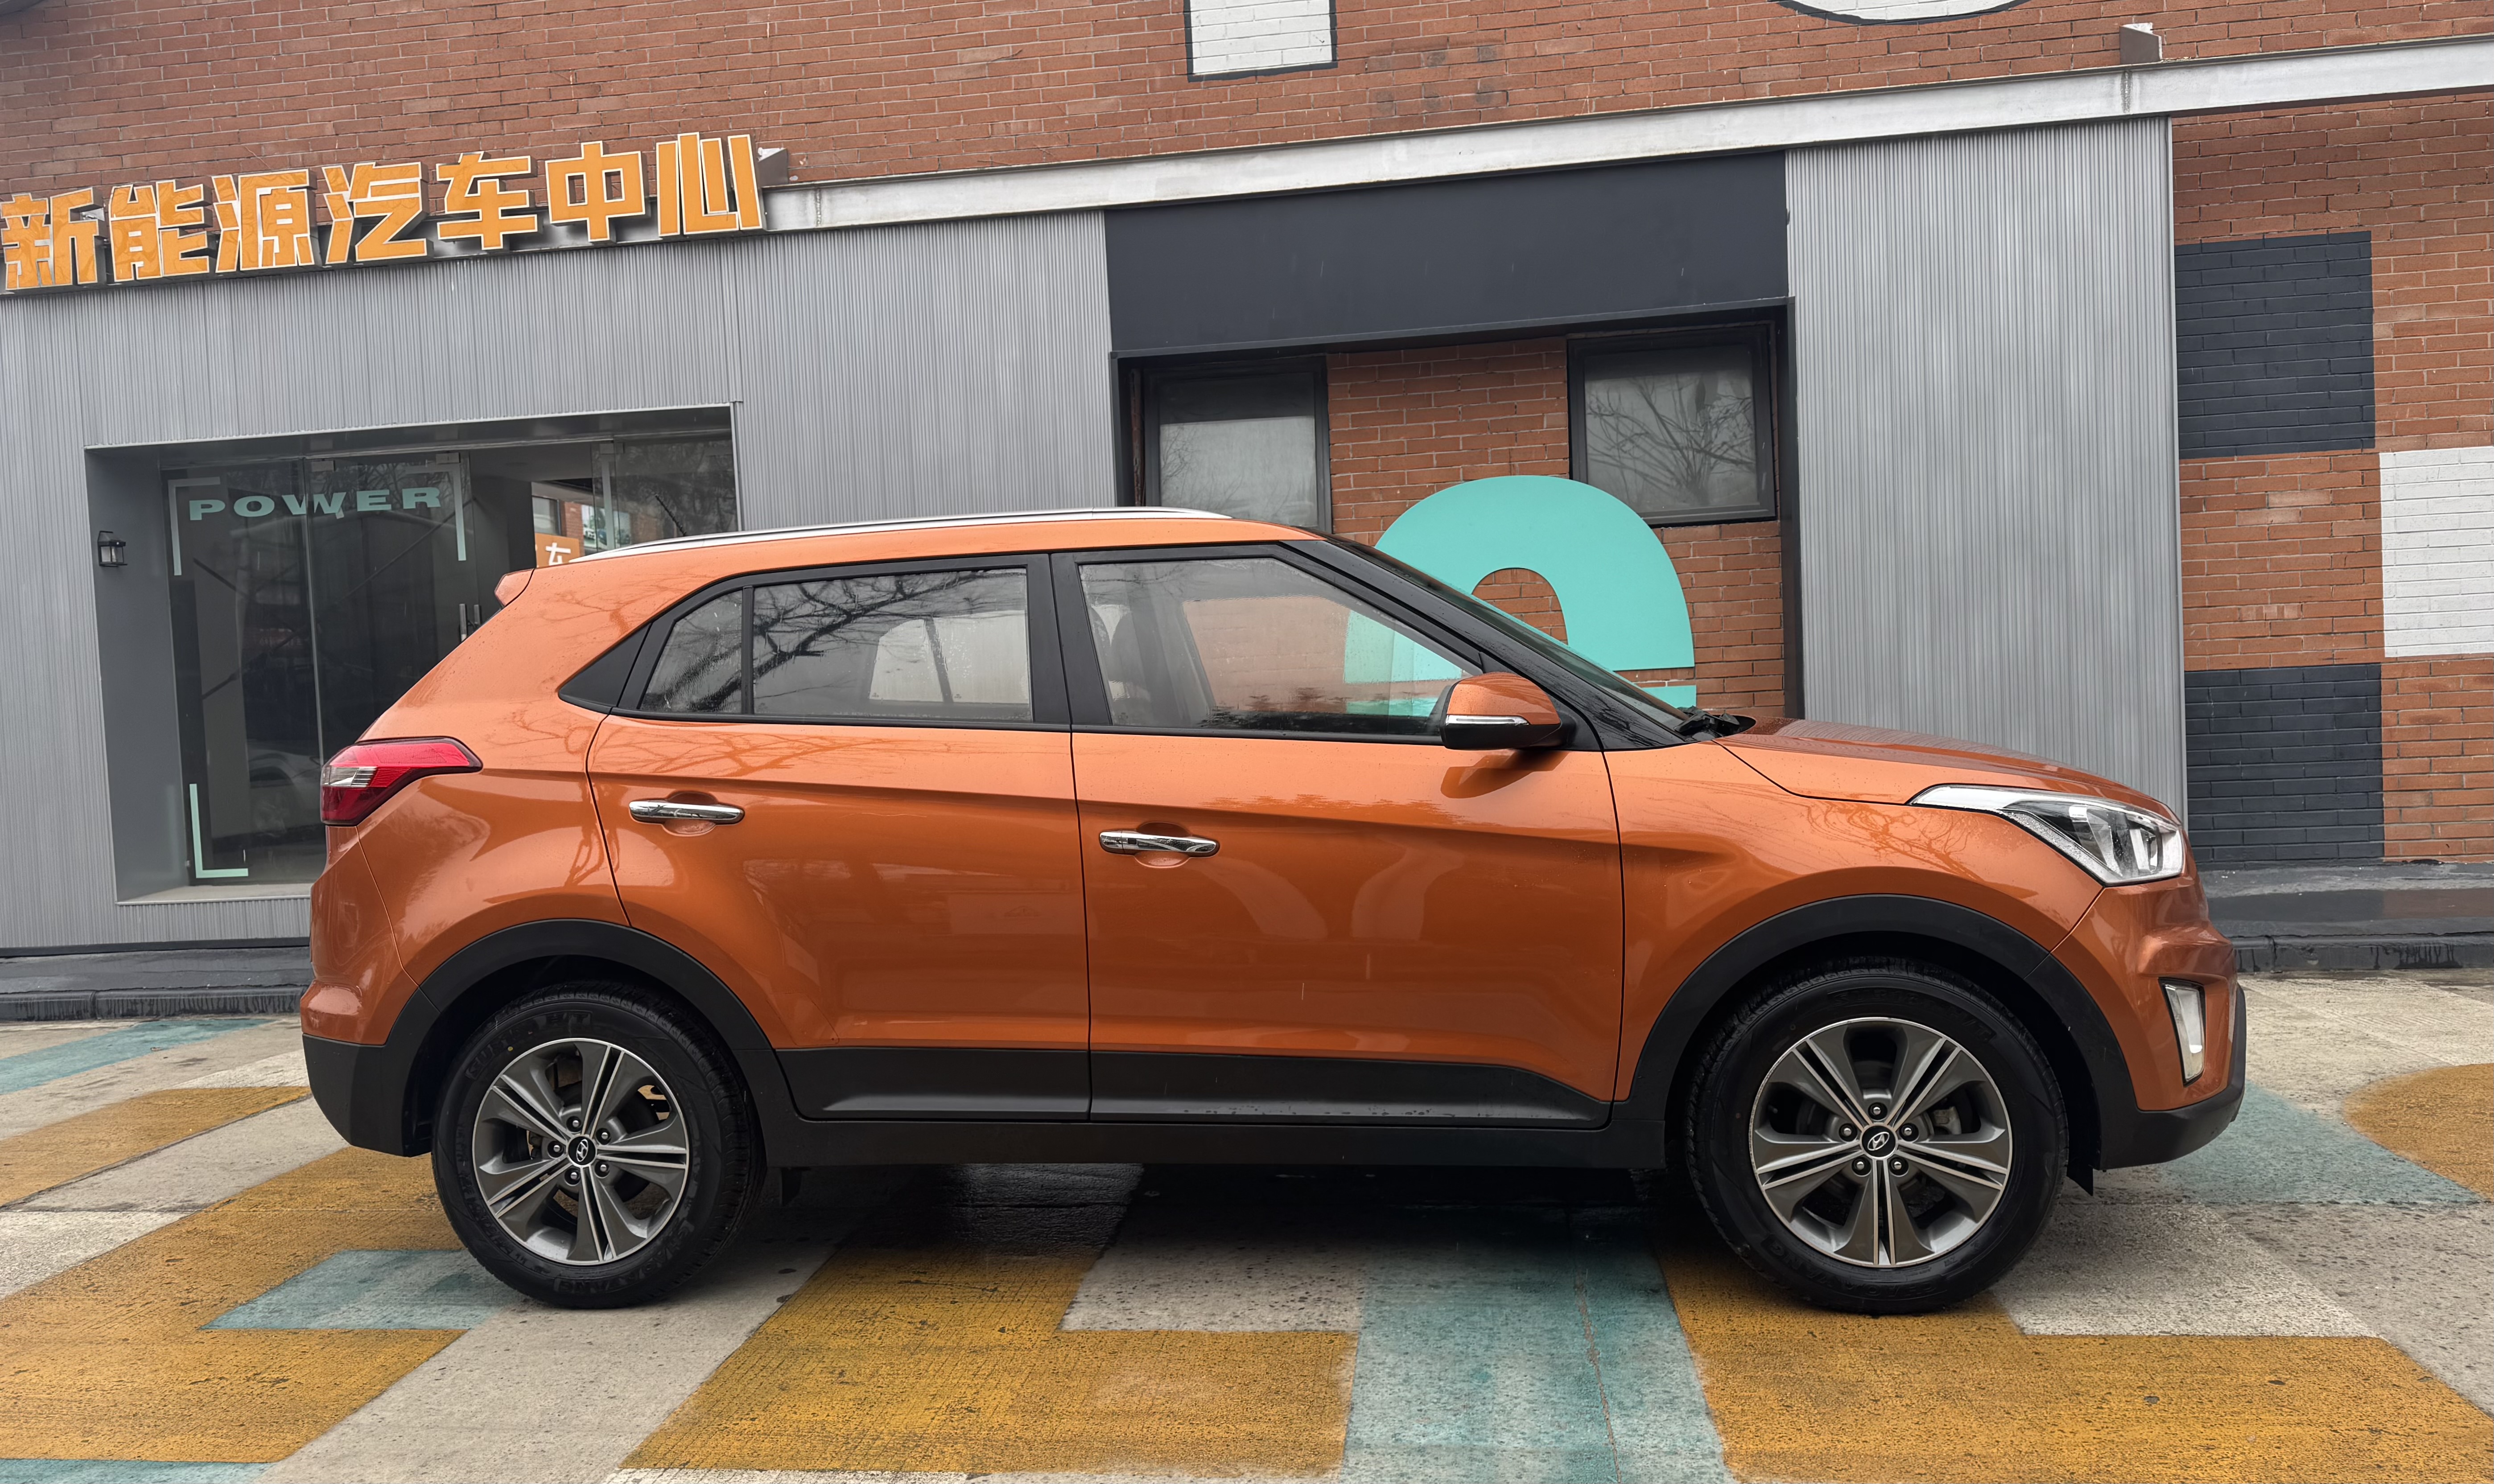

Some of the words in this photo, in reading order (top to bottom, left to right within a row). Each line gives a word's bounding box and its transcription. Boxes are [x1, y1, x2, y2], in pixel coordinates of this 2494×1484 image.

[0, 132, 763, 290] 新能源汽车中心
[189, 487, 441, 521] POWER
